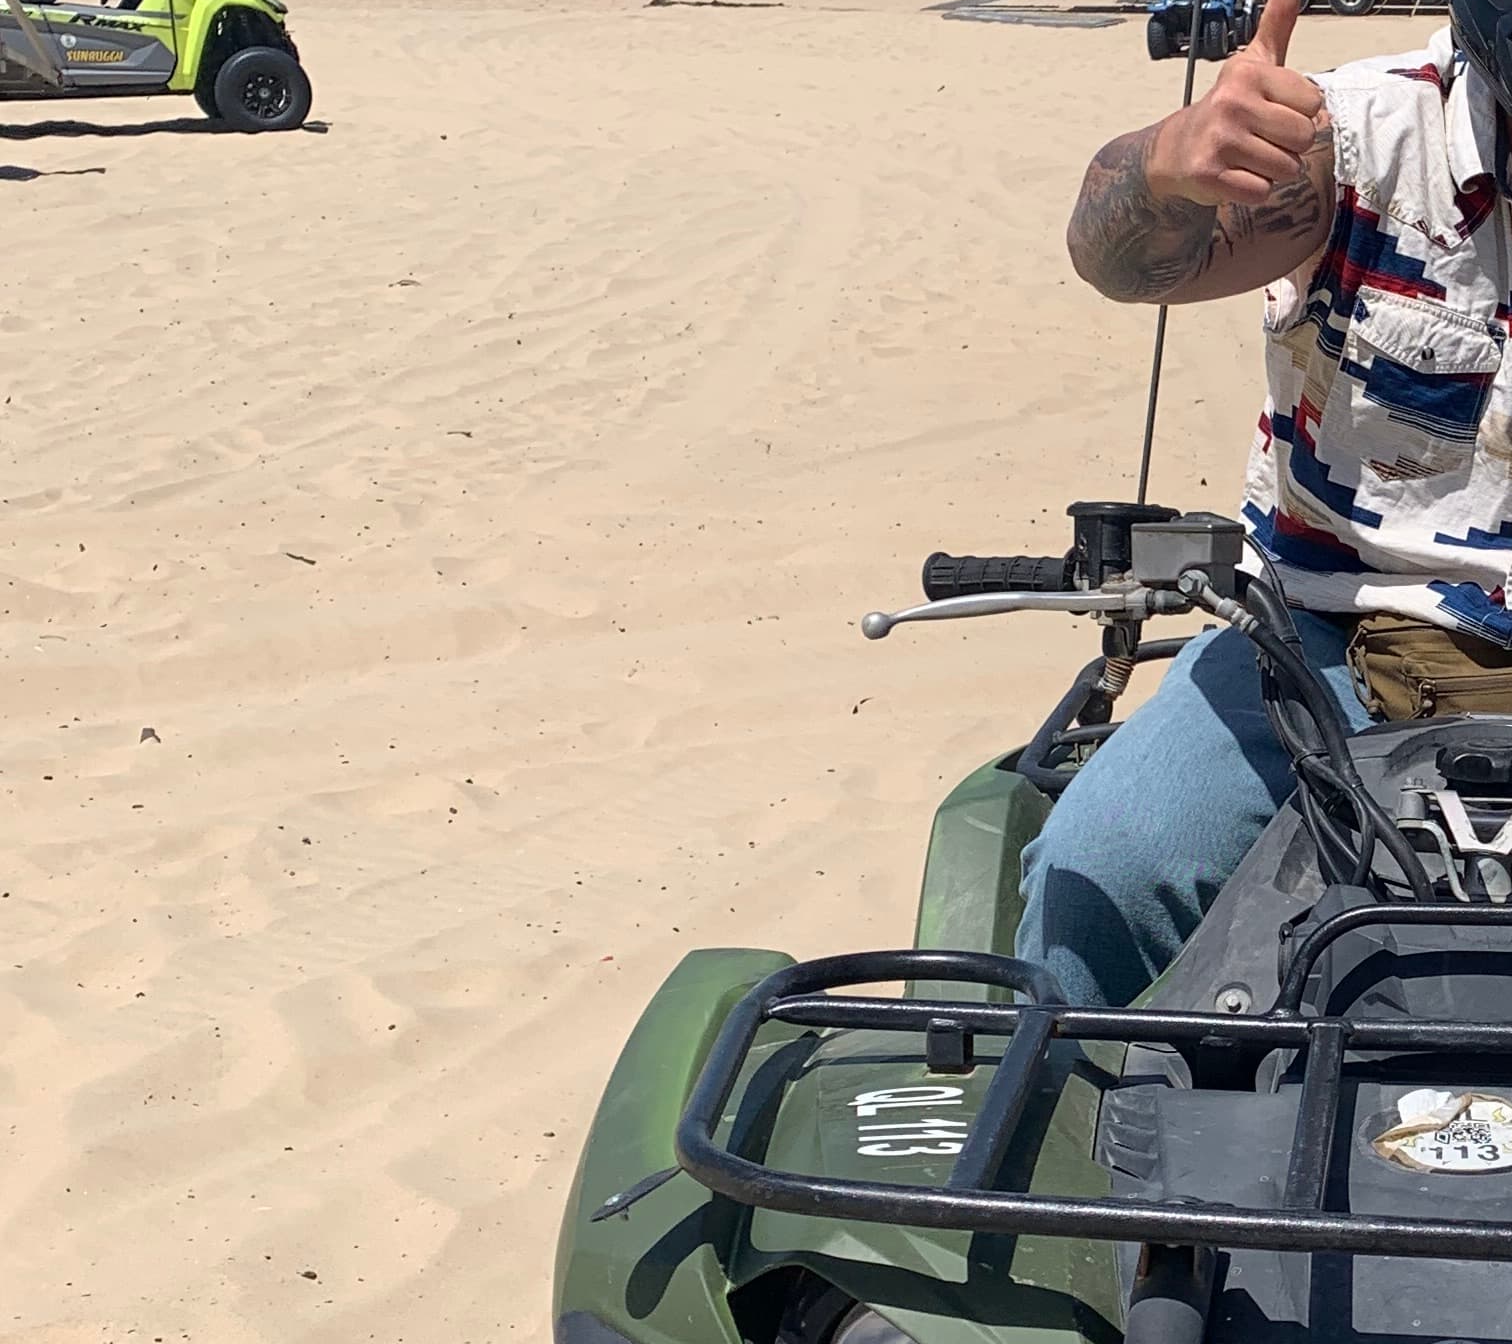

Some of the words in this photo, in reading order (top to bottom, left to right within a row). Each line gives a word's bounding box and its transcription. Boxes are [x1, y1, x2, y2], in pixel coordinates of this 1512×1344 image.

[847, 1086, 964, 1116] QL
[857, 1118, 968, 1156] 113
[1429, 1144, 1501, 1161] 113
